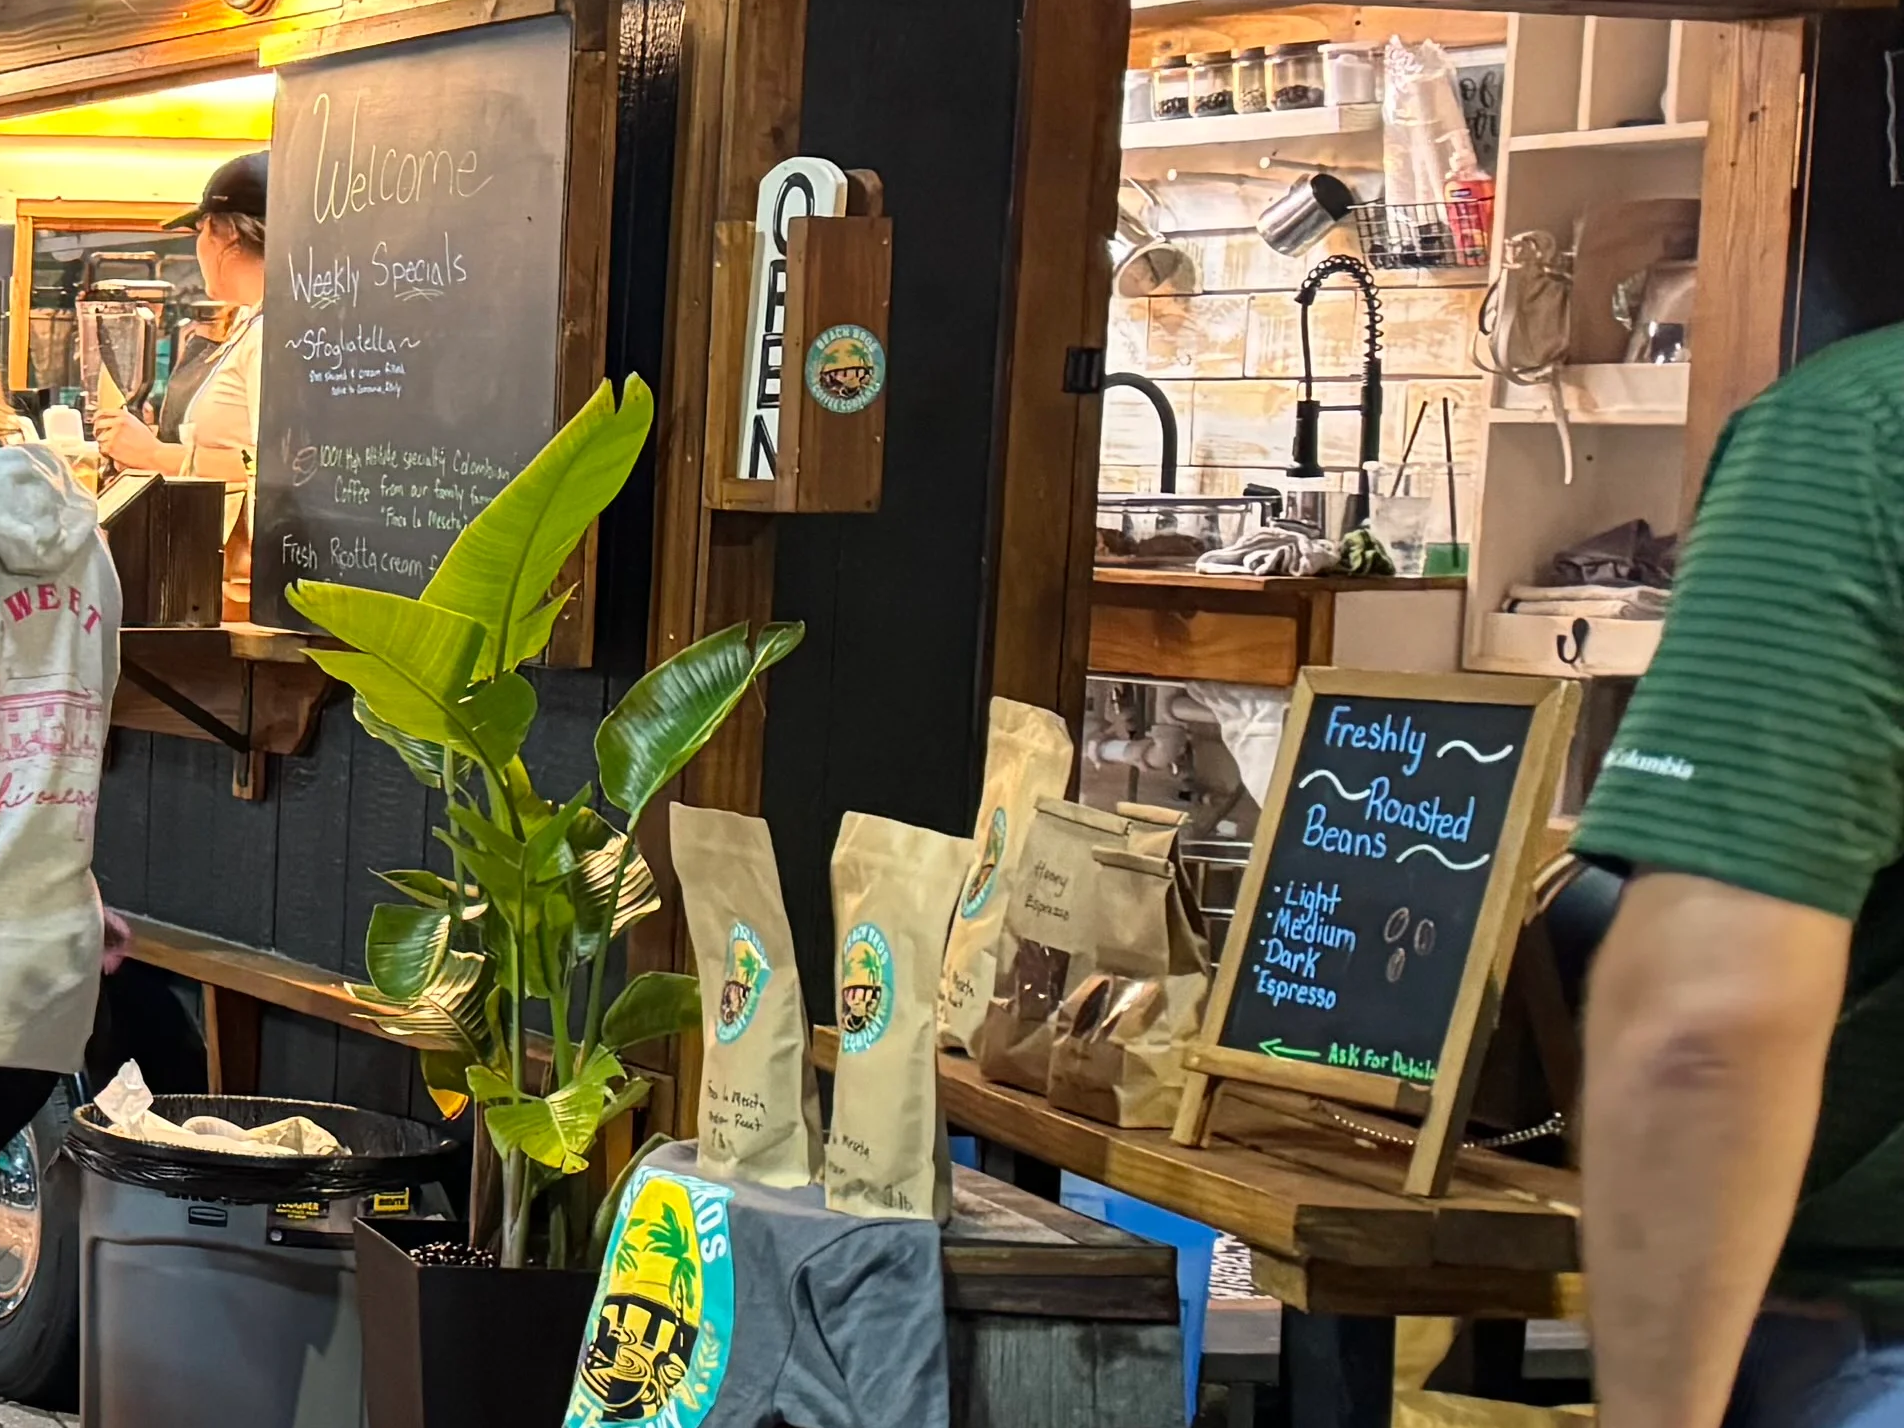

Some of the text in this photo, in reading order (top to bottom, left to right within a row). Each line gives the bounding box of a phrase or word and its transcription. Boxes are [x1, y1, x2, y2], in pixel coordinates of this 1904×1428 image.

[313, 92, 494, 224] Welcome
[287, 230, 468, 309] Weekly Specials
[334, 474, 371, 505] Coffee
[380, 473, 405, 497] from
[410, 483, 429, 499] our
[282, 533, 319, 571] Fresh
[380, 551, 424, 581] cream
[3, 582, 103, 635] WEET
[1324, 705, 1427, 776] Freshly
[1614, 748, 1695, 782] Columbia
[1302, 802, 1388, 860] Beans
[1364, 776, 1476, 843] Roasted
[1284, 881, 1342, 924] Light
[1272, 907, 1357, 954] Medium
[1264, 937, 1322, 979] Dark
[1256, 969, 1338, 1010] Espresso
